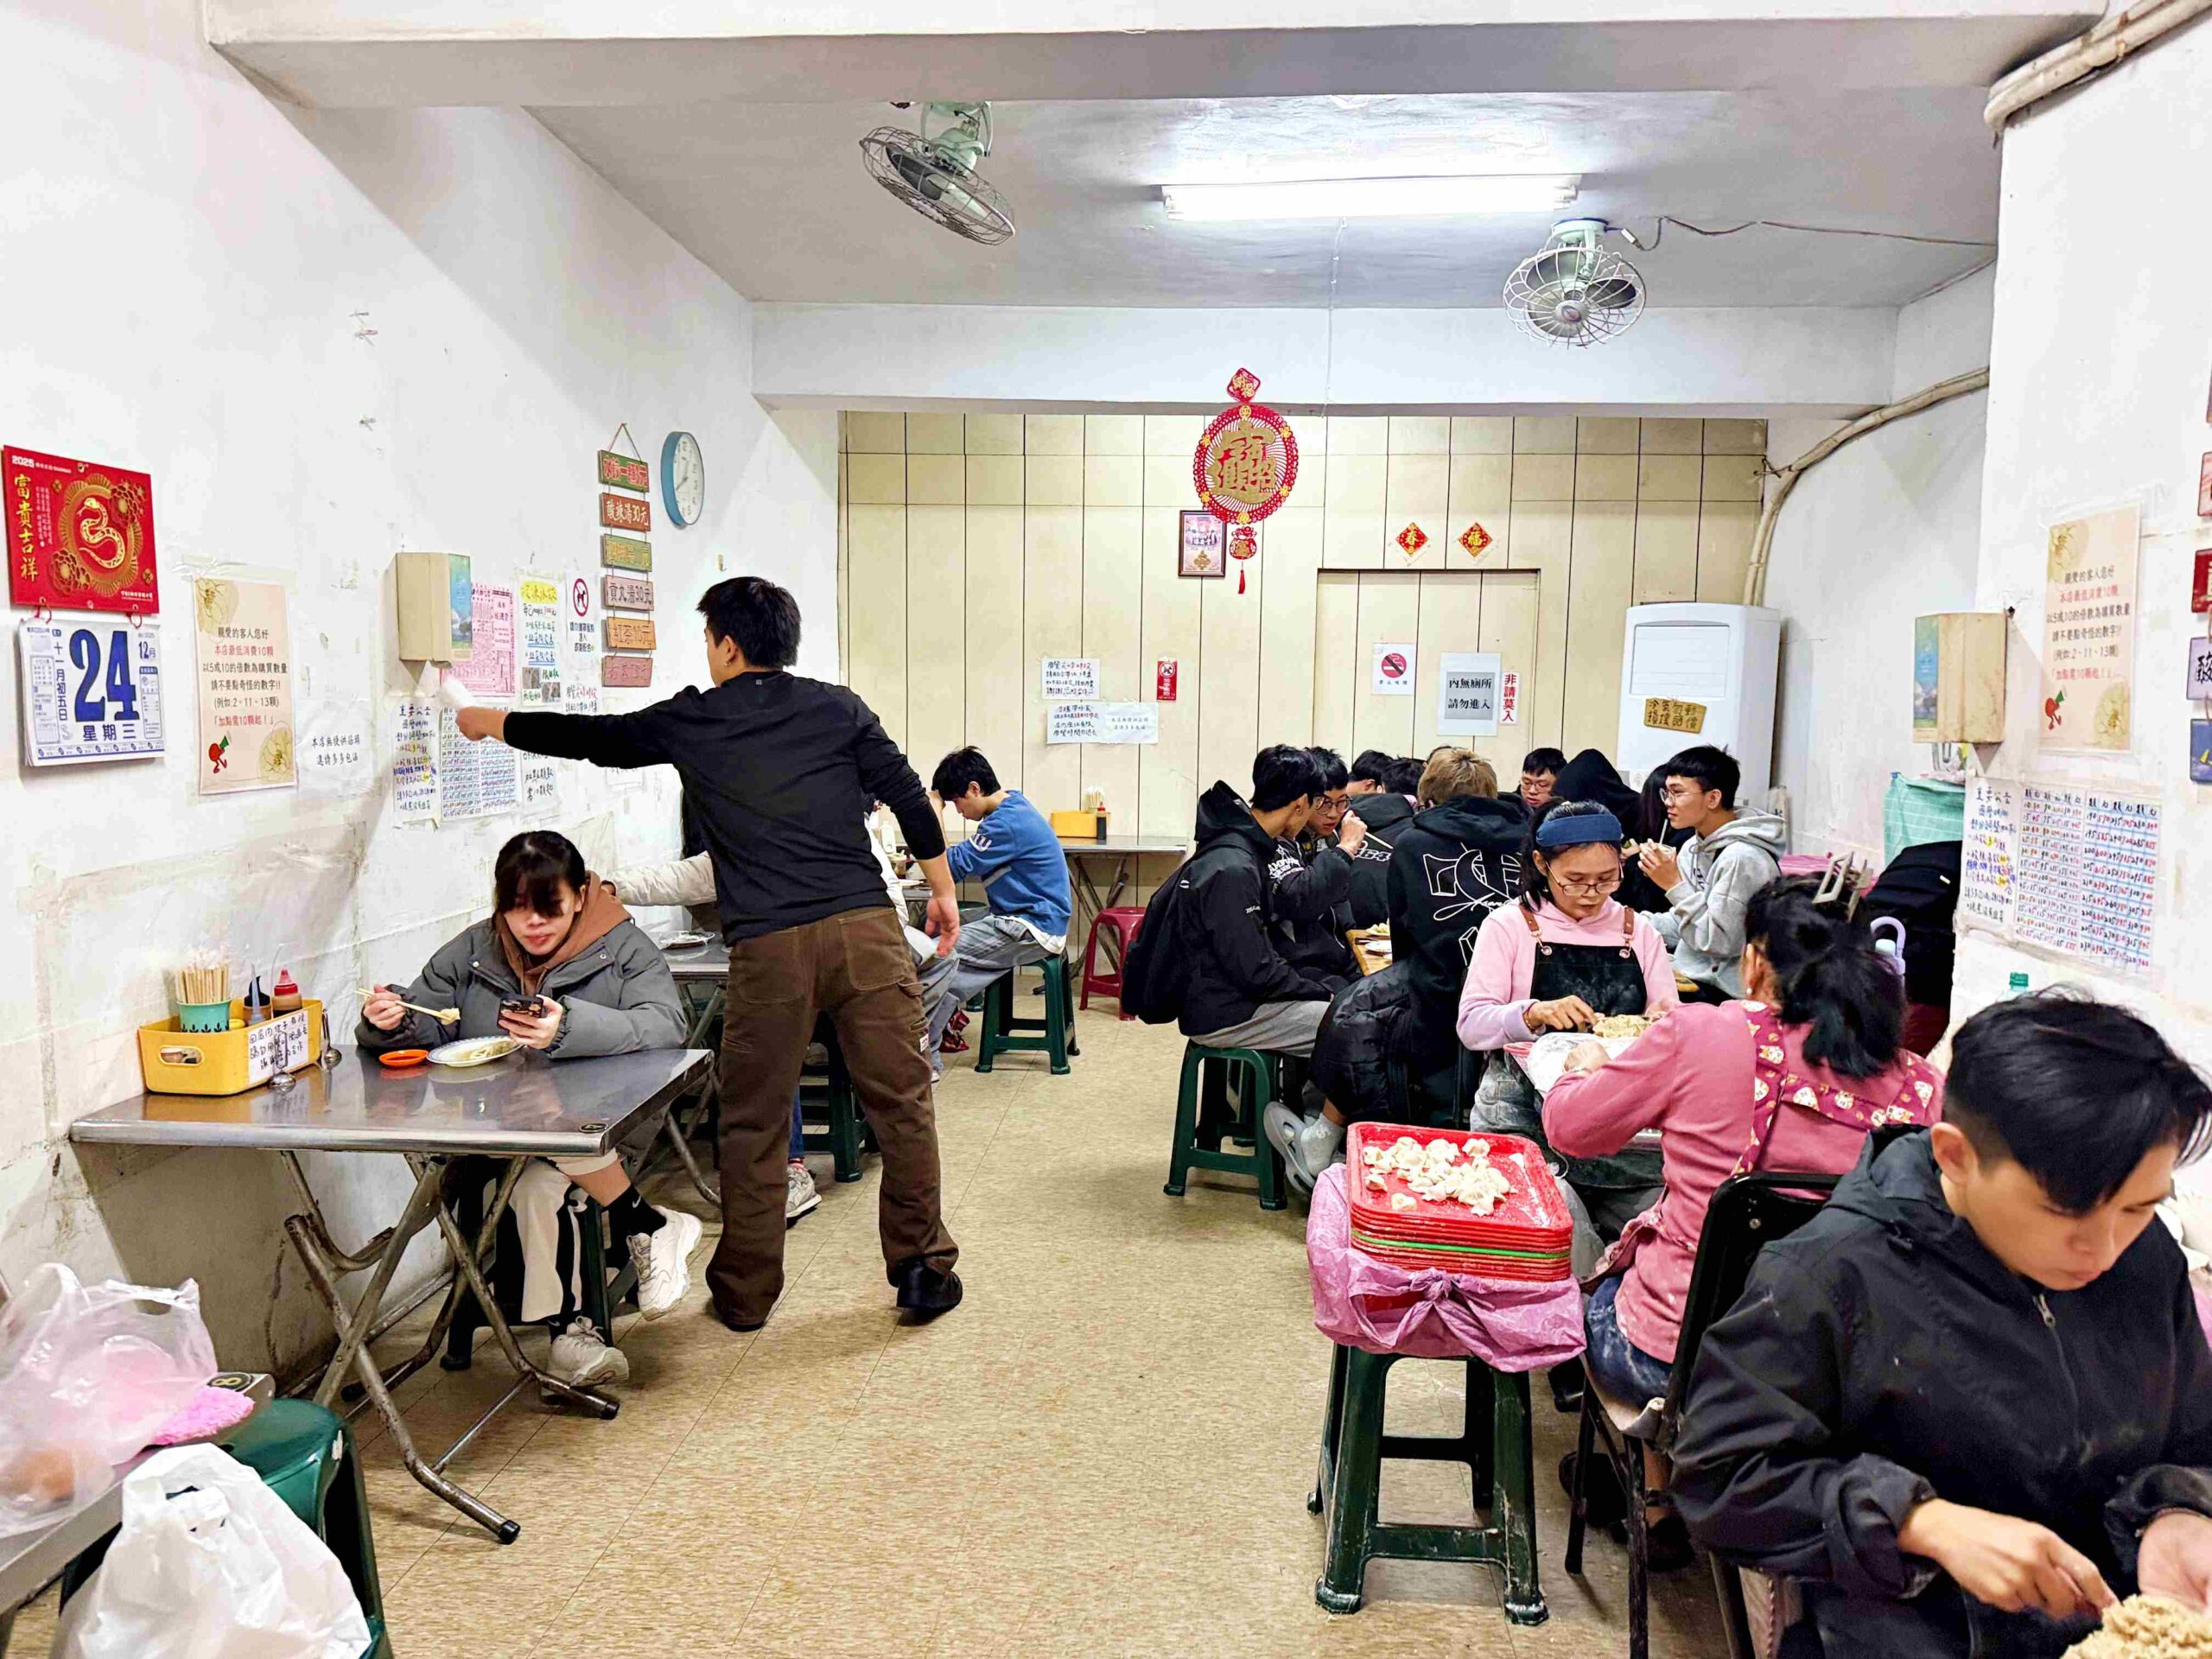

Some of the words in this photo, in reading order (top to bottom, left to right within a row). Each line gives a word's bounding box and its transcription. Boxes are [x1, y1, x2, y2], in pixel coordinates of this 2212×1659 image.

[12, 454, 35, 468] 2025
[14, 473, 38, 582] 富貴吉祥
[138, 641, 156, 659] 12月
[54, 642, 68, 721] 十一月初五日
[69, 629, 140, 721] 24
[1449, 677, 1492, 689] 內無廁所
[1448, 698, 1491, 709] 請勿進入
[1503, 673, 1517, 722] 非請莫入
[83, 723, 137, 741] 星期三
